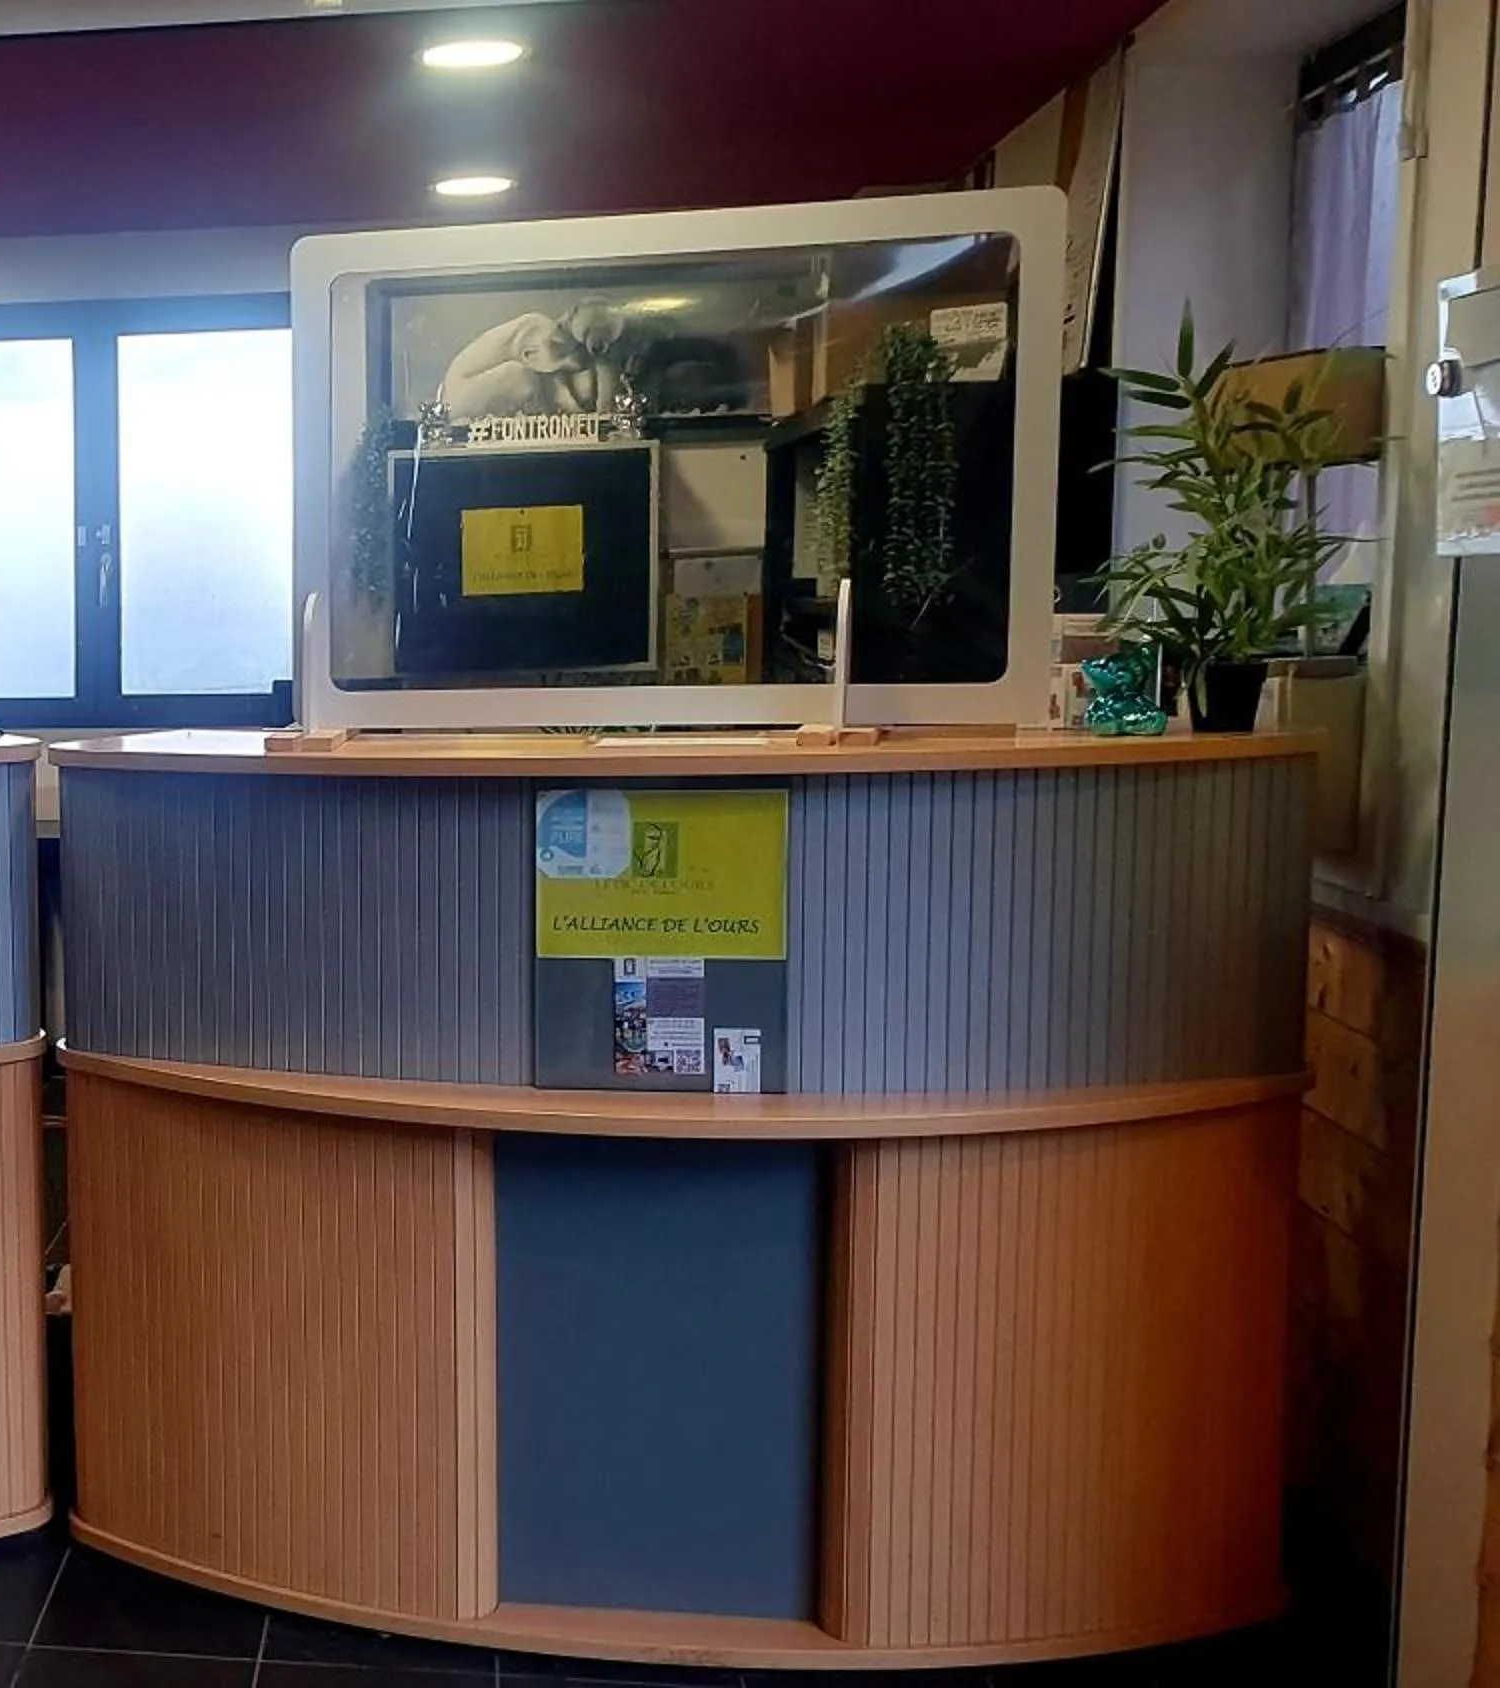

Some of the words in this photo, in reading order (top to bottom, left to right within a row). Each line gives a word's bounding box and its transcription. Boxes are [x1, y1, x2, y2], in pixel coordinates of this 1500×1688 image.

[552, 915, 659, 931] L'ALLIANCE
[662, 917, 689, 933] DE
[693, 916, 761, 935] L'OURS
